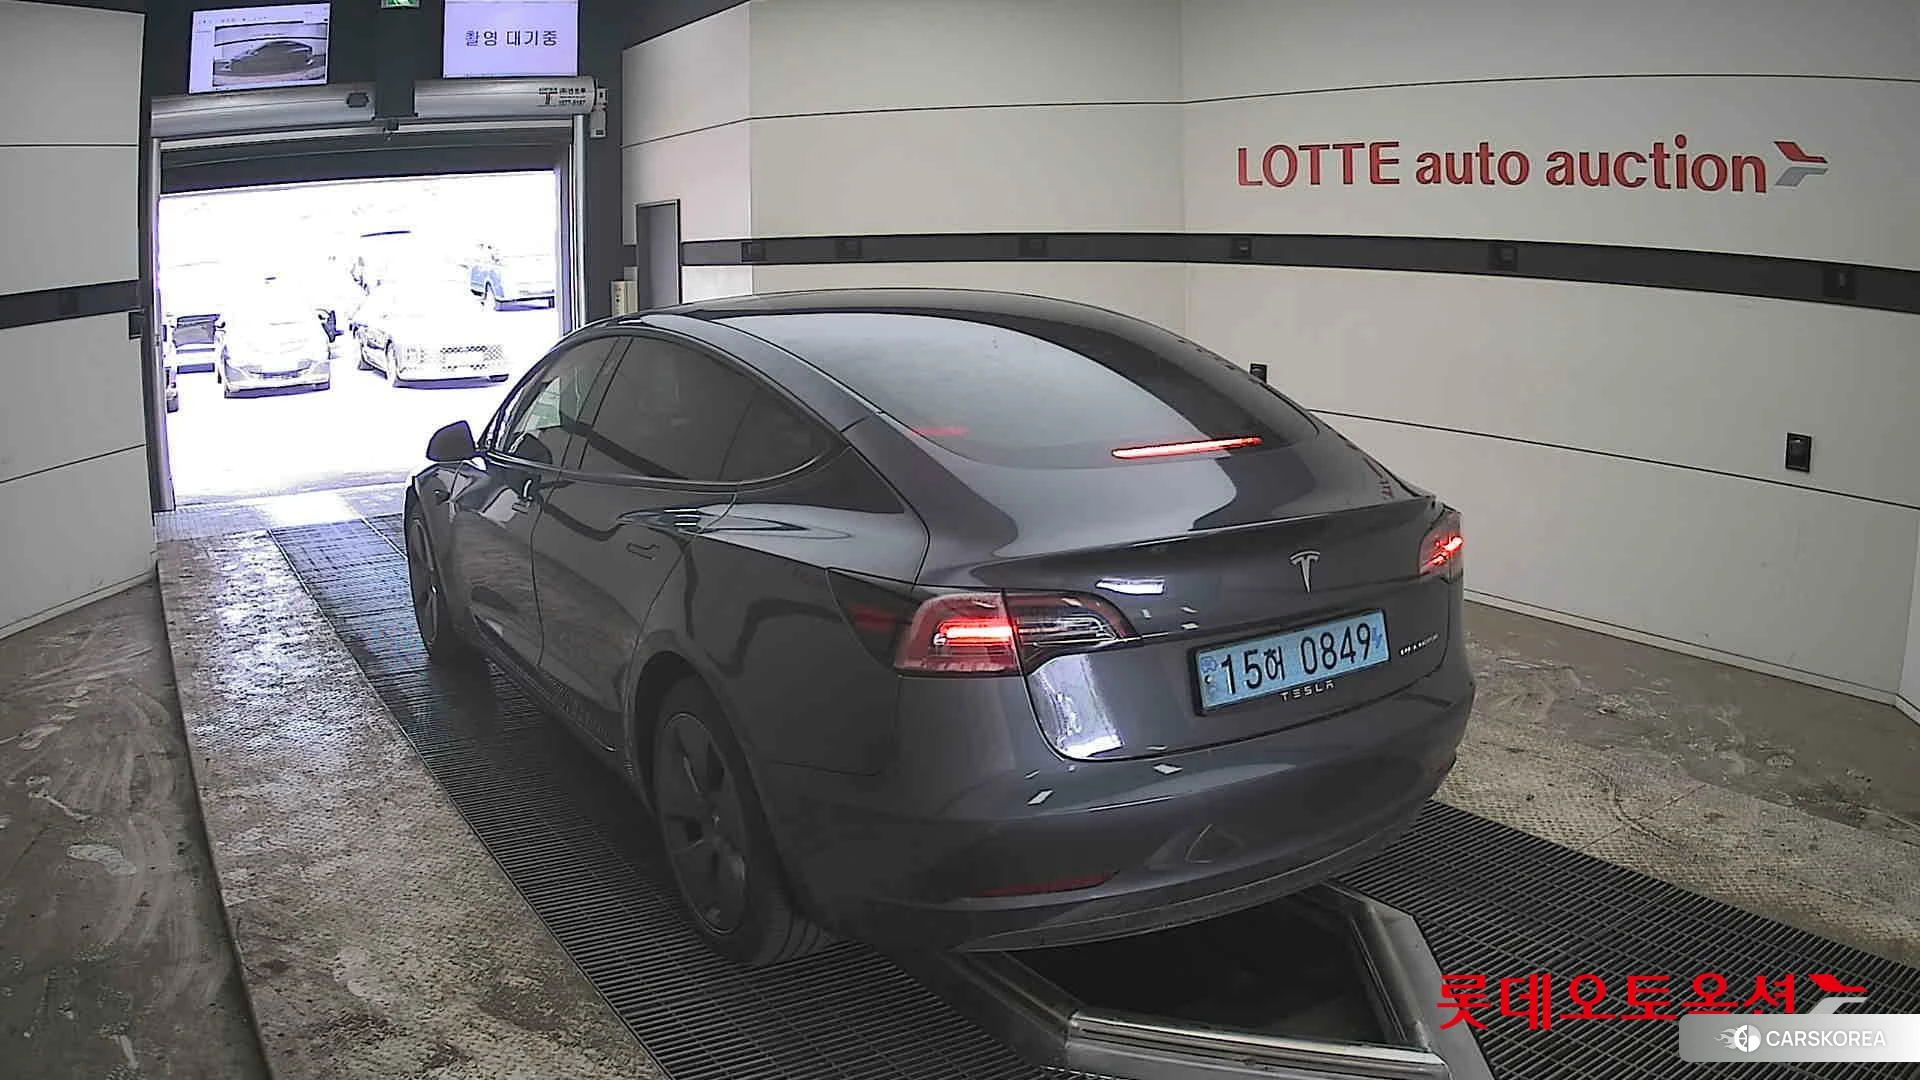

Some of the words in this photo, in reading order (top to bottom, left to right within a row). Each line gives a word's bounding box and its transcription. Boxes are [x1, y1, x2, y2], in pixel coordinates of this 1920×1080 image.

[506, 30, 557, 47] 대기중
[1237, 142, 1400, 188] LOTTE
[1415, 142, 1530, 186] auto
[1546, 135, 1767, 193] auction
[1221, 645, 1286, 695] 15허
[1300, 623, 1371, 675] 0849
[1279, 679, 1336, 701] TESLA
